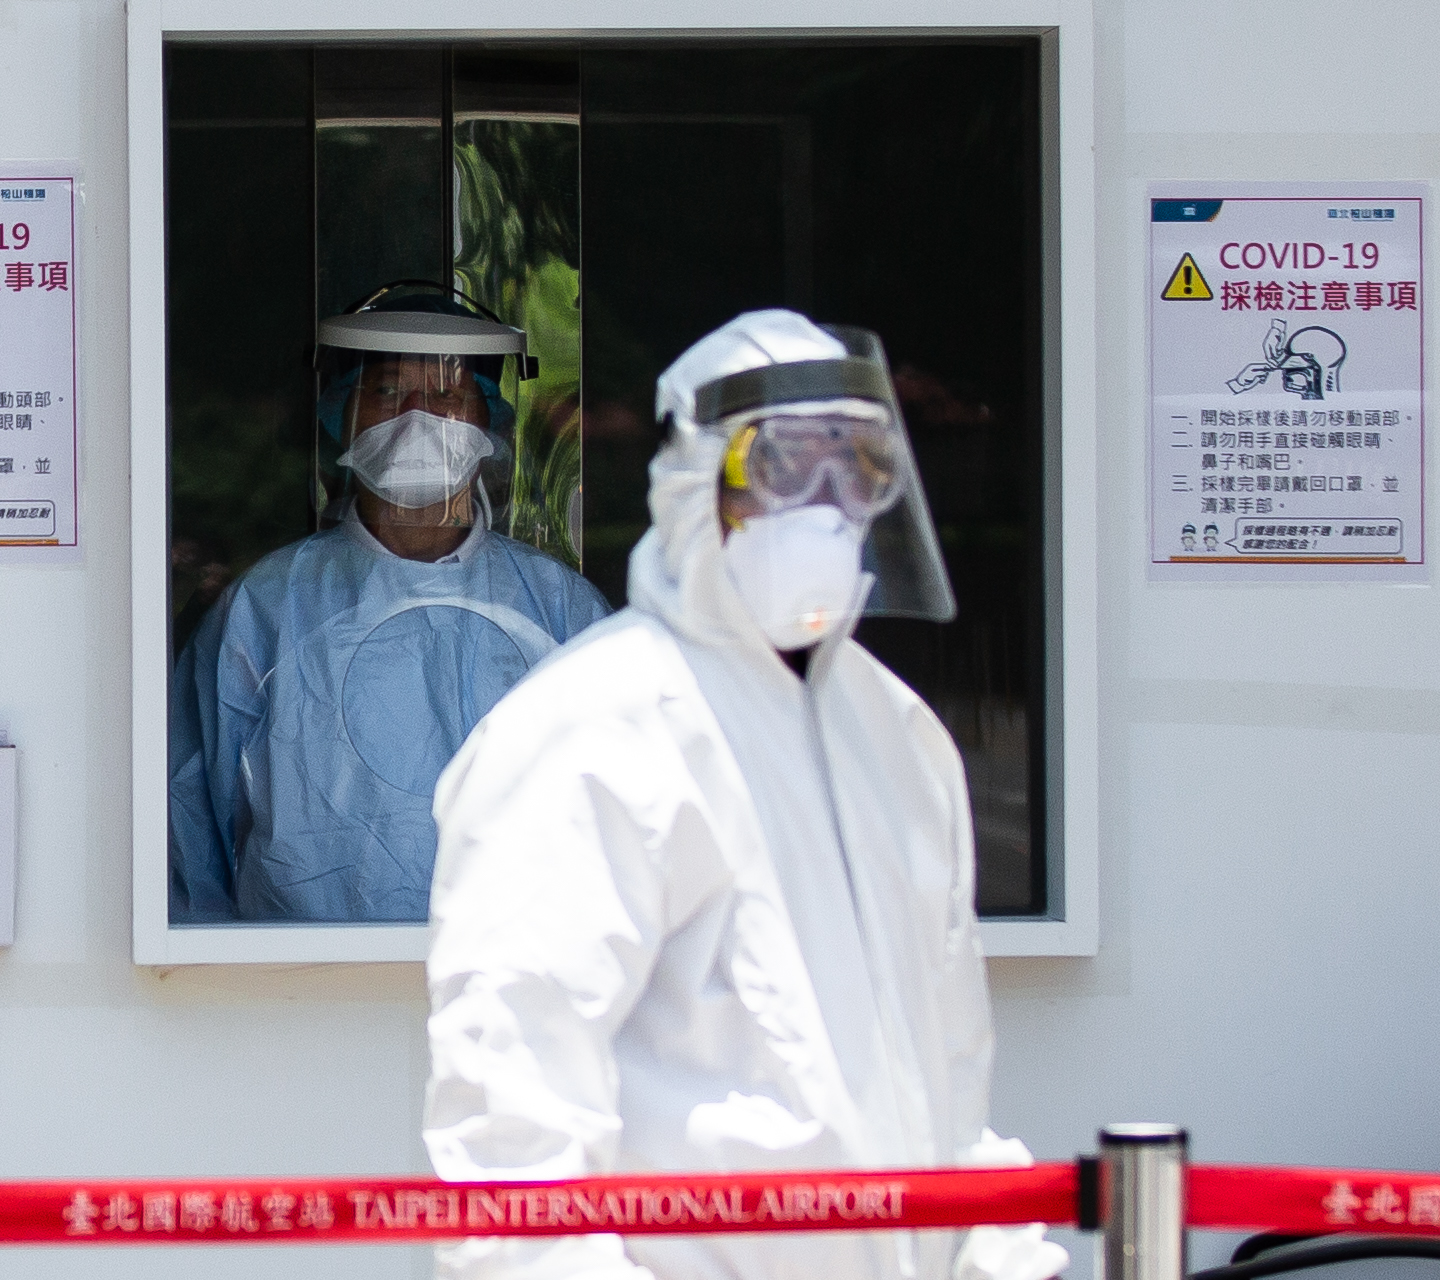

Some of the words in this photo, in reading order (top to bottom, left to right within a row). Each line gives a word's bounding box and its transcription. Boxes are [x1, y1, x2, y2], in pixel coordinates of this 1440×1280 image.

[1220, 242, 1379, 270] COVID-19
[1221, 281, 1416, 311] 採檢注意事項
[346, 1189, 460, 1230] TAIPEI
[466, 1185, 752, 1228] INTERNATIONAL
[752, 1181, 907, 1222] AIRPORT
